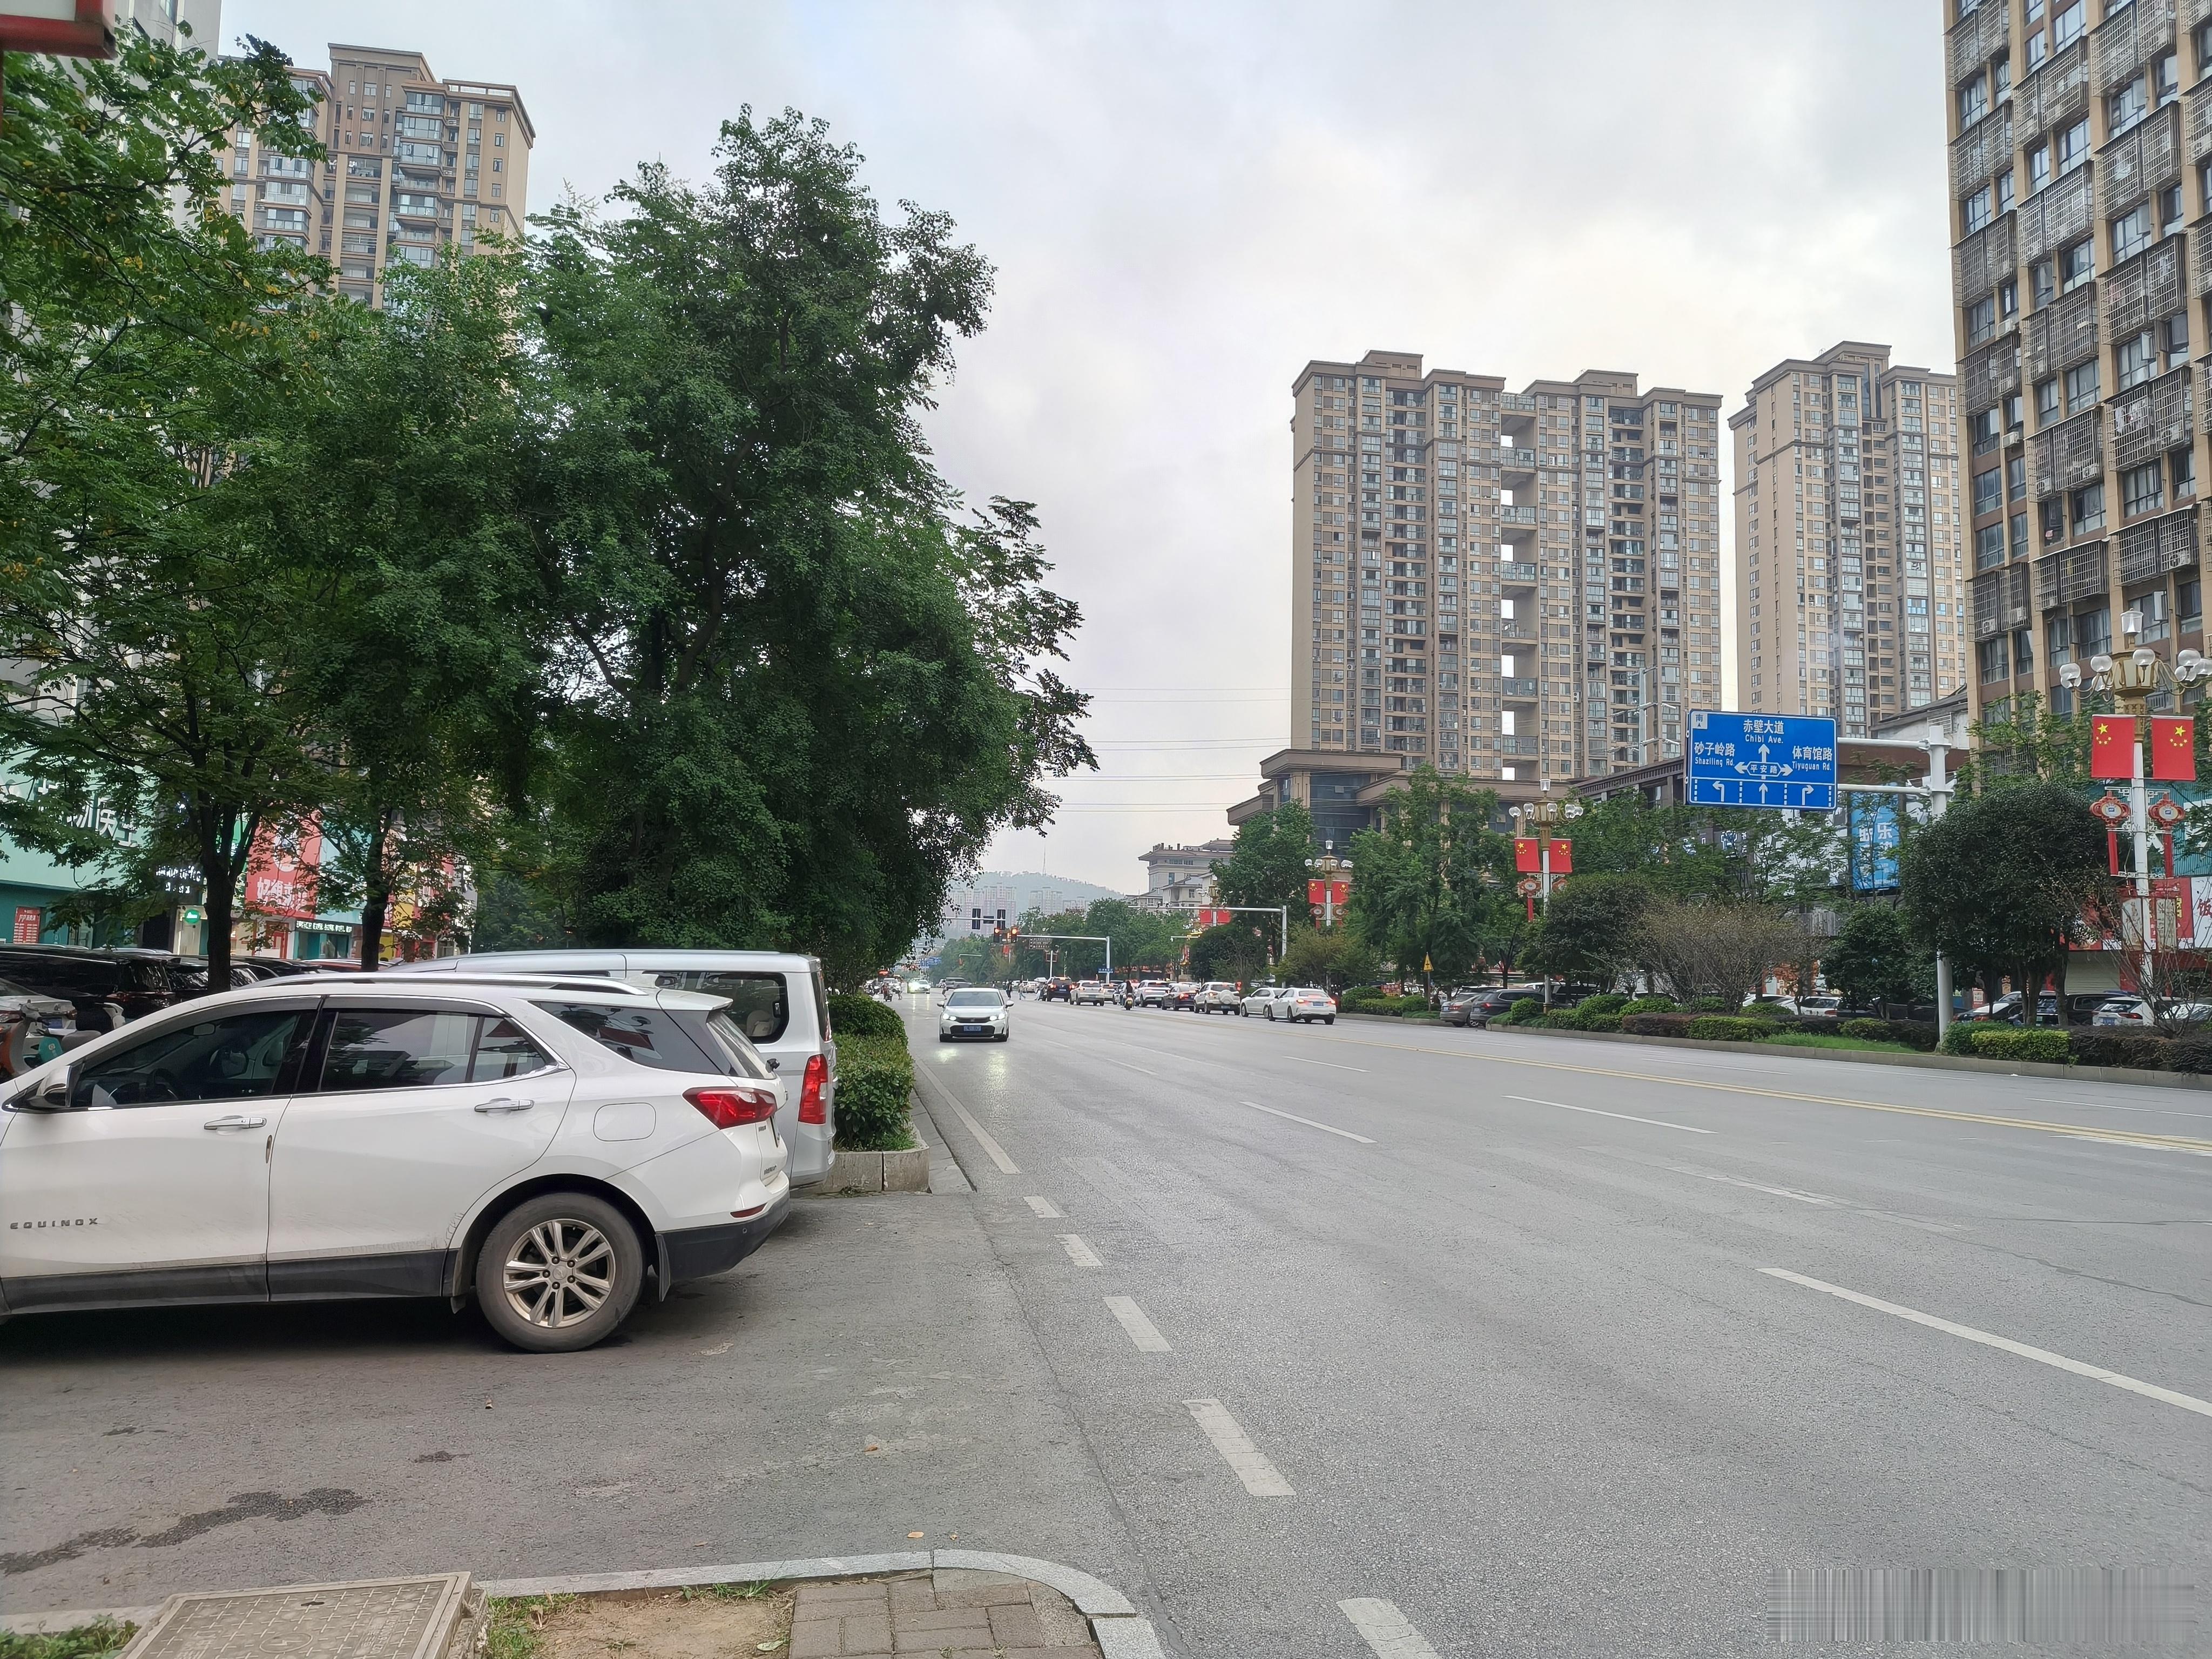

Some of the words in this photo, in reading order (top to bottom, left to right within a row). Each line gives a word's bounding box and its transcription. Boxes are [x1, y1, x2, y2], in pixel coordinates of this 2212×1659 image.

[1695, 714, 1703, 722] 南
[1743, 718, 1784, 734] 赤壁大道
[1745, 734, 1764, 743] Chibi
[1768, 735, 1784, 744] Ave.
[1694, 741, 1736, 757] 砂子岭路
[1792, 745, 1833, 761] 体育馆路
[1695, 757, 1723, 767] Shaziling
[1726, 758, 1735, 766] Rd.
[1792, 761, 1819, 772] Tiyuguan
[1822, 762, 1832, 771] Rd.
[1750, 765, 1778, 774] 平安路
[10, 1218, 98, 1230] EQUINOX
